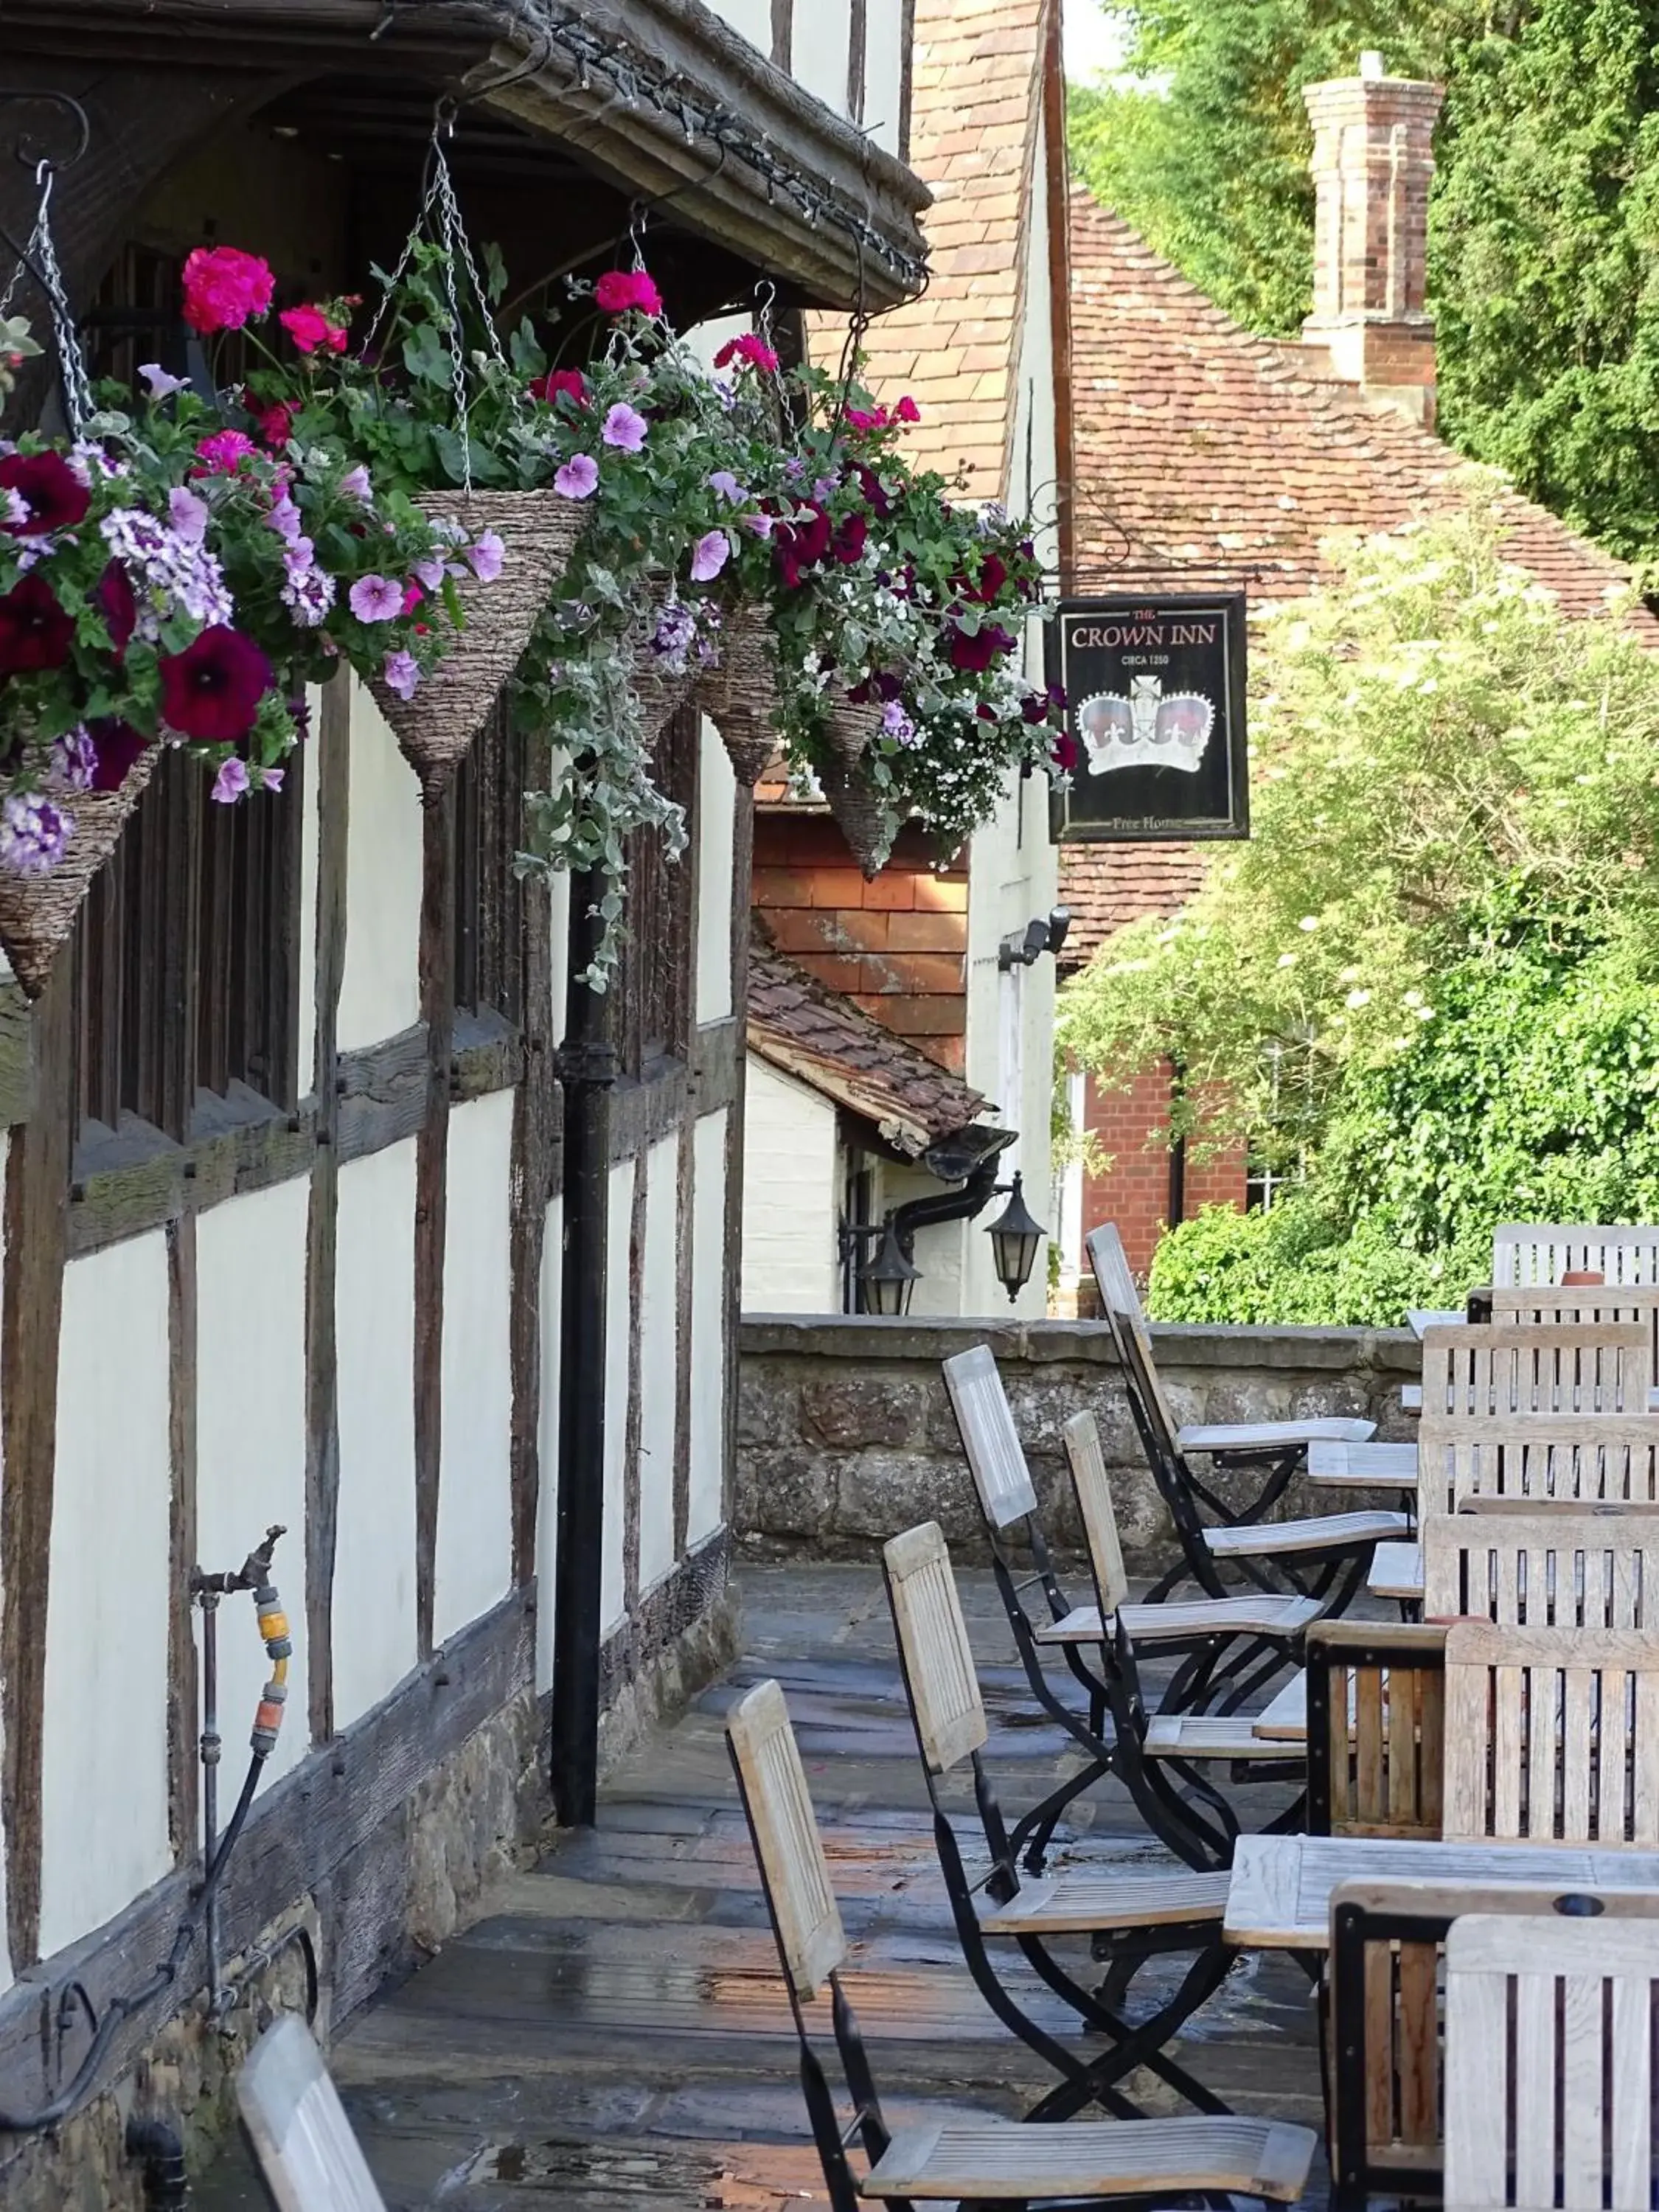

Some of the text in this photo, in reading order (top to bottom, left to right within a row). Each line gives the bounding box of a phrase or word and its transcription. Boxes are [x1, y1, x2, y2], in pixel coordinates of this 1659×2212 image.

[1133, 610, 1155, 620] THE
[1072, 625, 1216, 647] CROWN INN
[1121, 655, 1147, 665] CIRCA
[1113, 817, 1139, 830] Free
